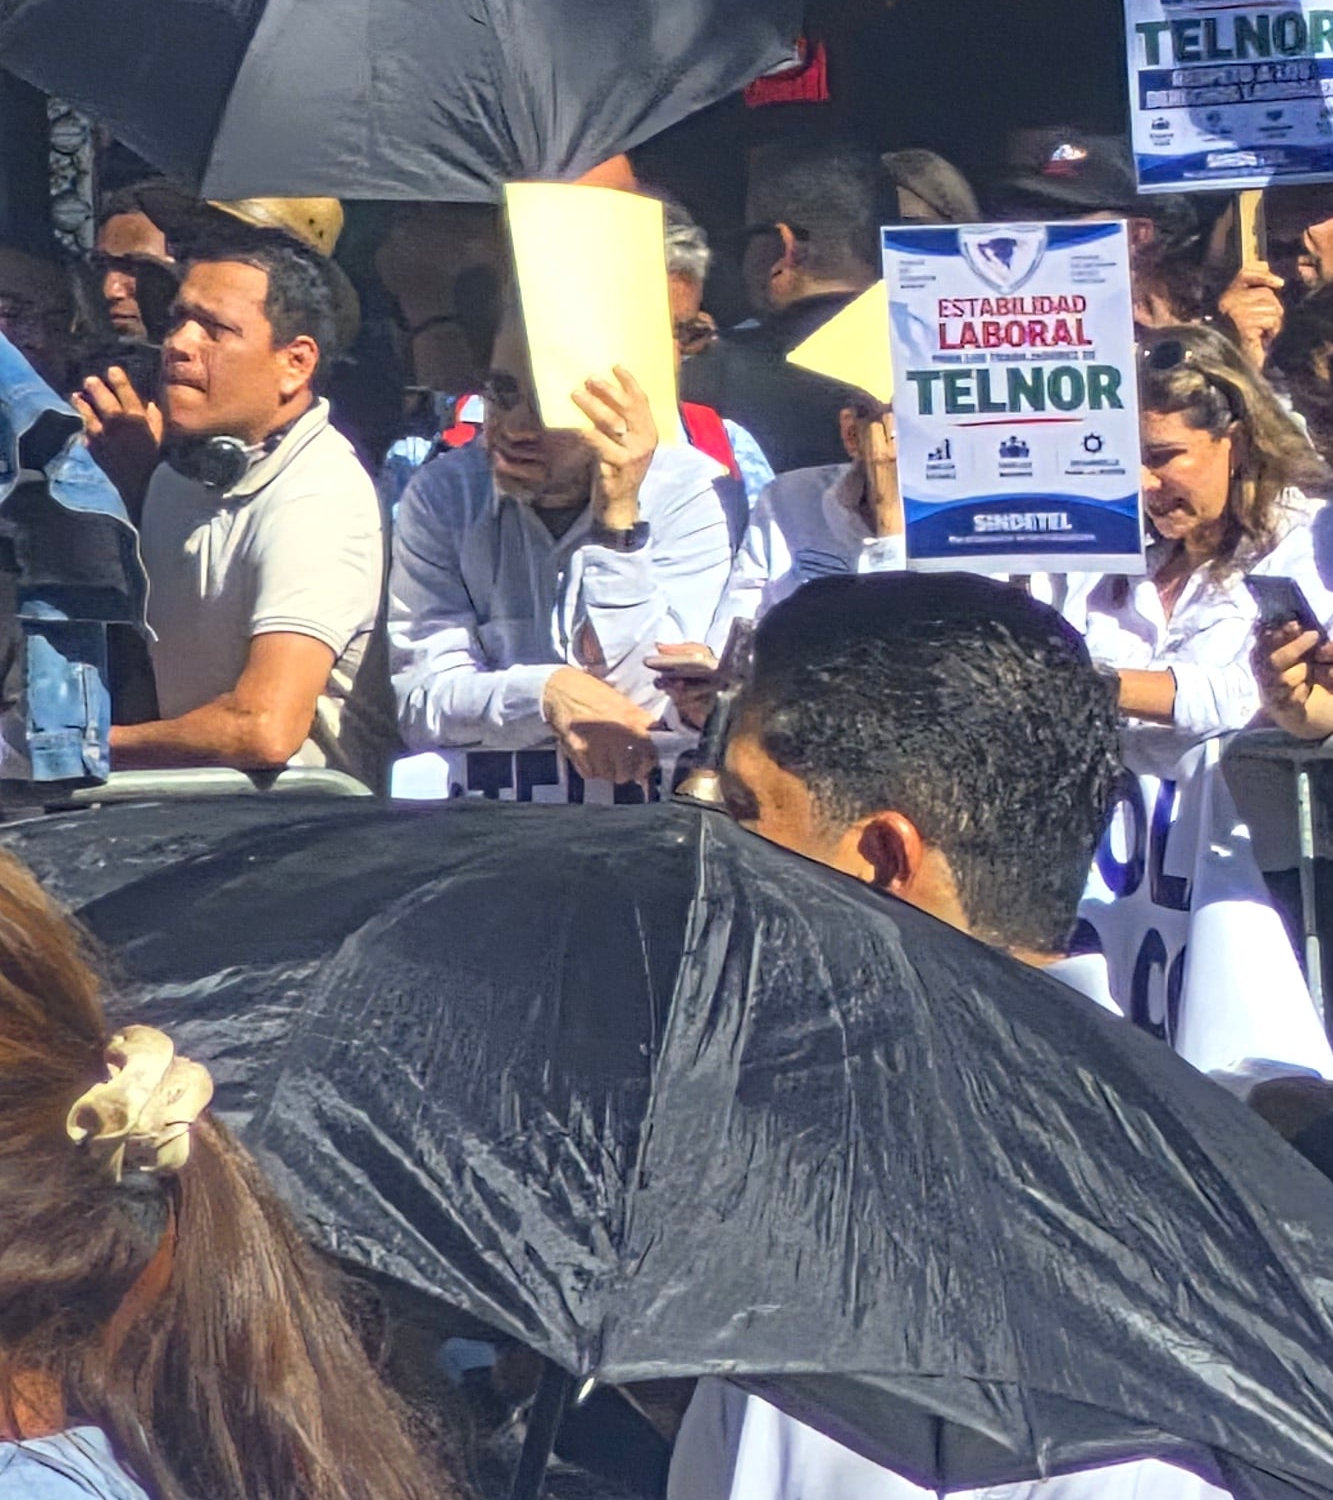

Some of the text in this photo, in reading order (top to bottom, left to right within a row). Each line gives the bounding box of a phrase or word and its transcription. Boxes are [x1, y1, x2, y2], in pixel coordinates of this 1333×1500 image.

[938, 295, 1086, 318] ESTABILIDAD
[939, 318, 1093, 350] LABORAL
[906, 364, 1124, 415] TELNOR
